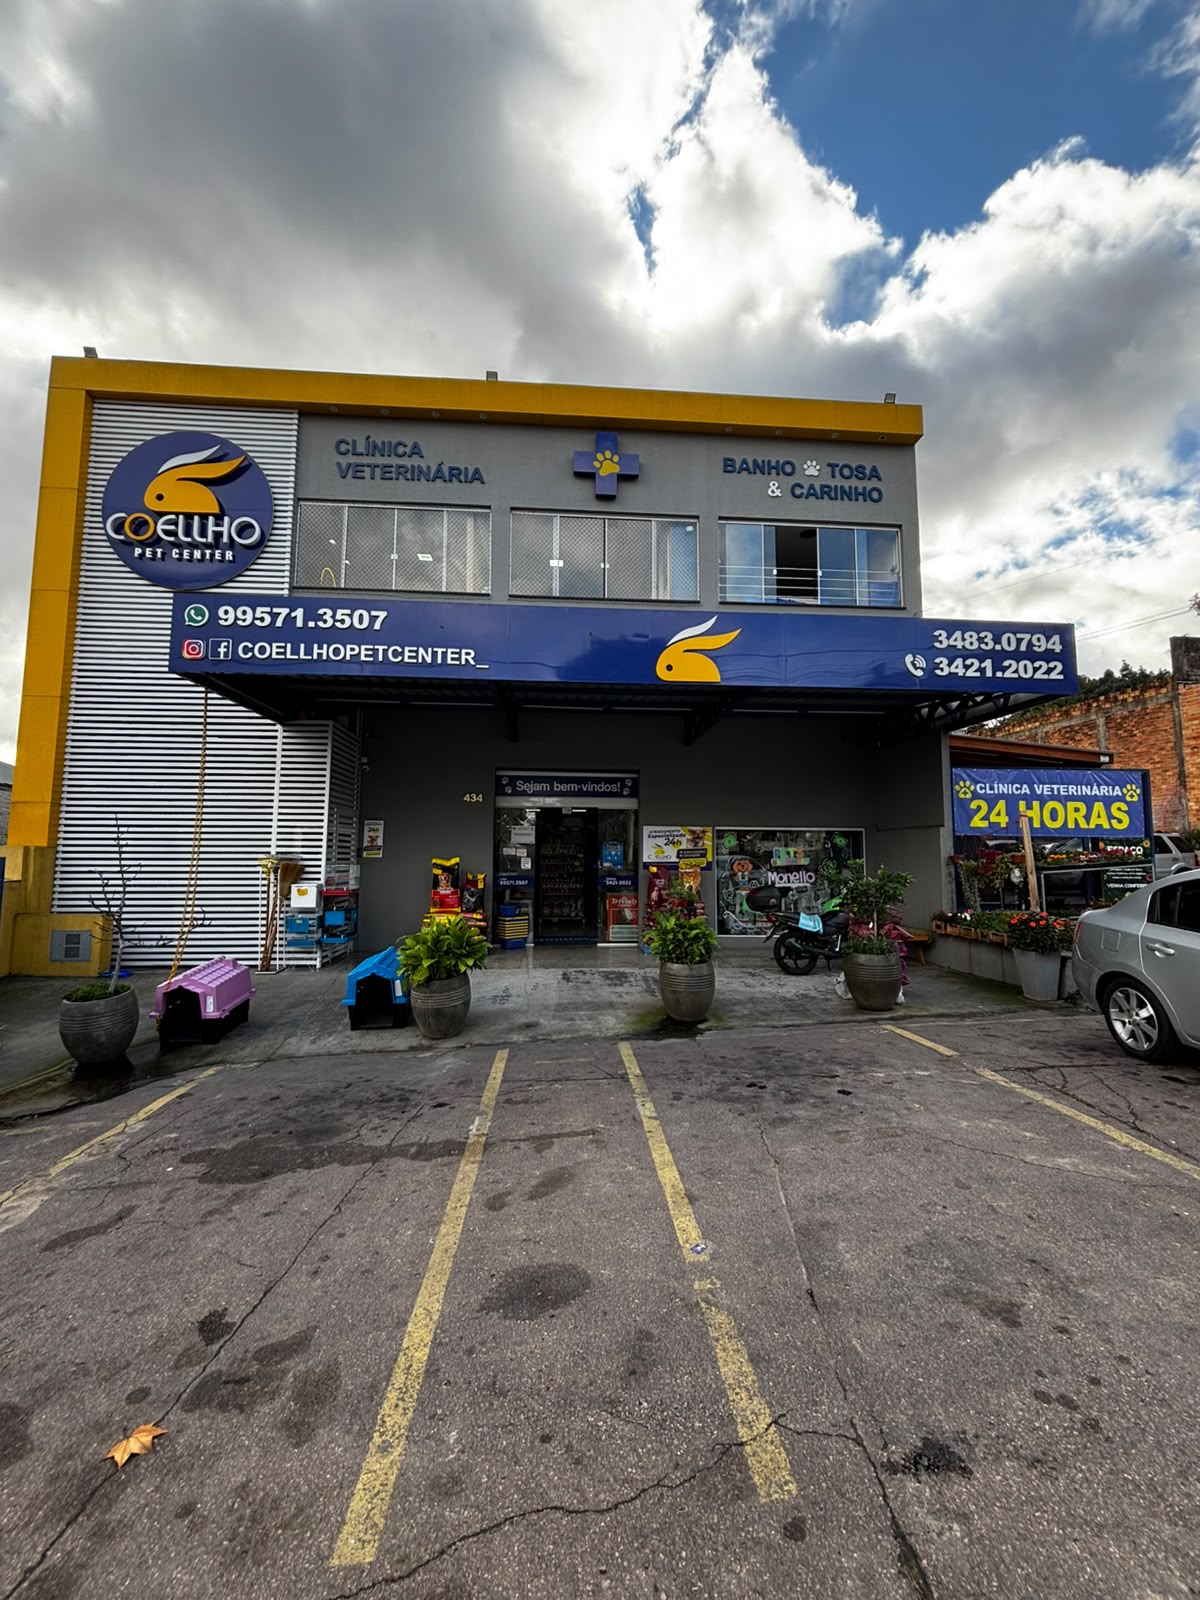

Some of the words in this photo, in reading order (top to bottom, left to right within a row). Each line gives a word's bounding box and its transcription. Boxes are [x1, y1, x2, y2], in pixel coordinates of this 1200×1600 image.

[335, 435, 424, 458] CLÍNICA
[336, 461, 485, 484] VETERINÁRIA
[723, 457, 796, 477] BANHO
[827, 462, 882, 481] TOSA
[767, 480, 783, 498] &
[790, 482, 883, 503] CARINHO
[106, 512, 262, 546] COELLHO
[134, 547, 164, 559] PET
[171, 548, 234, 561] CENTER
[217, 605, 388, 631] 99571.3507
[933, 629, 1063, 653] 3483.0794
[933, 656, 1065, 680] 3421.2022
[463, 792, 483, 803] 434
[516, 780, 550, 794] Sejam
[554, 780, 621, 793] bem-vindos!
[976, 780, 1030, 796] CLÍNICA
[1034, 783, 1123, 797] VETERINÁRIA
[969, 799, 1009, 828] 24
[1018, 800, 1131, 830] HORAS
[768, 870, 816, 885] Monello
